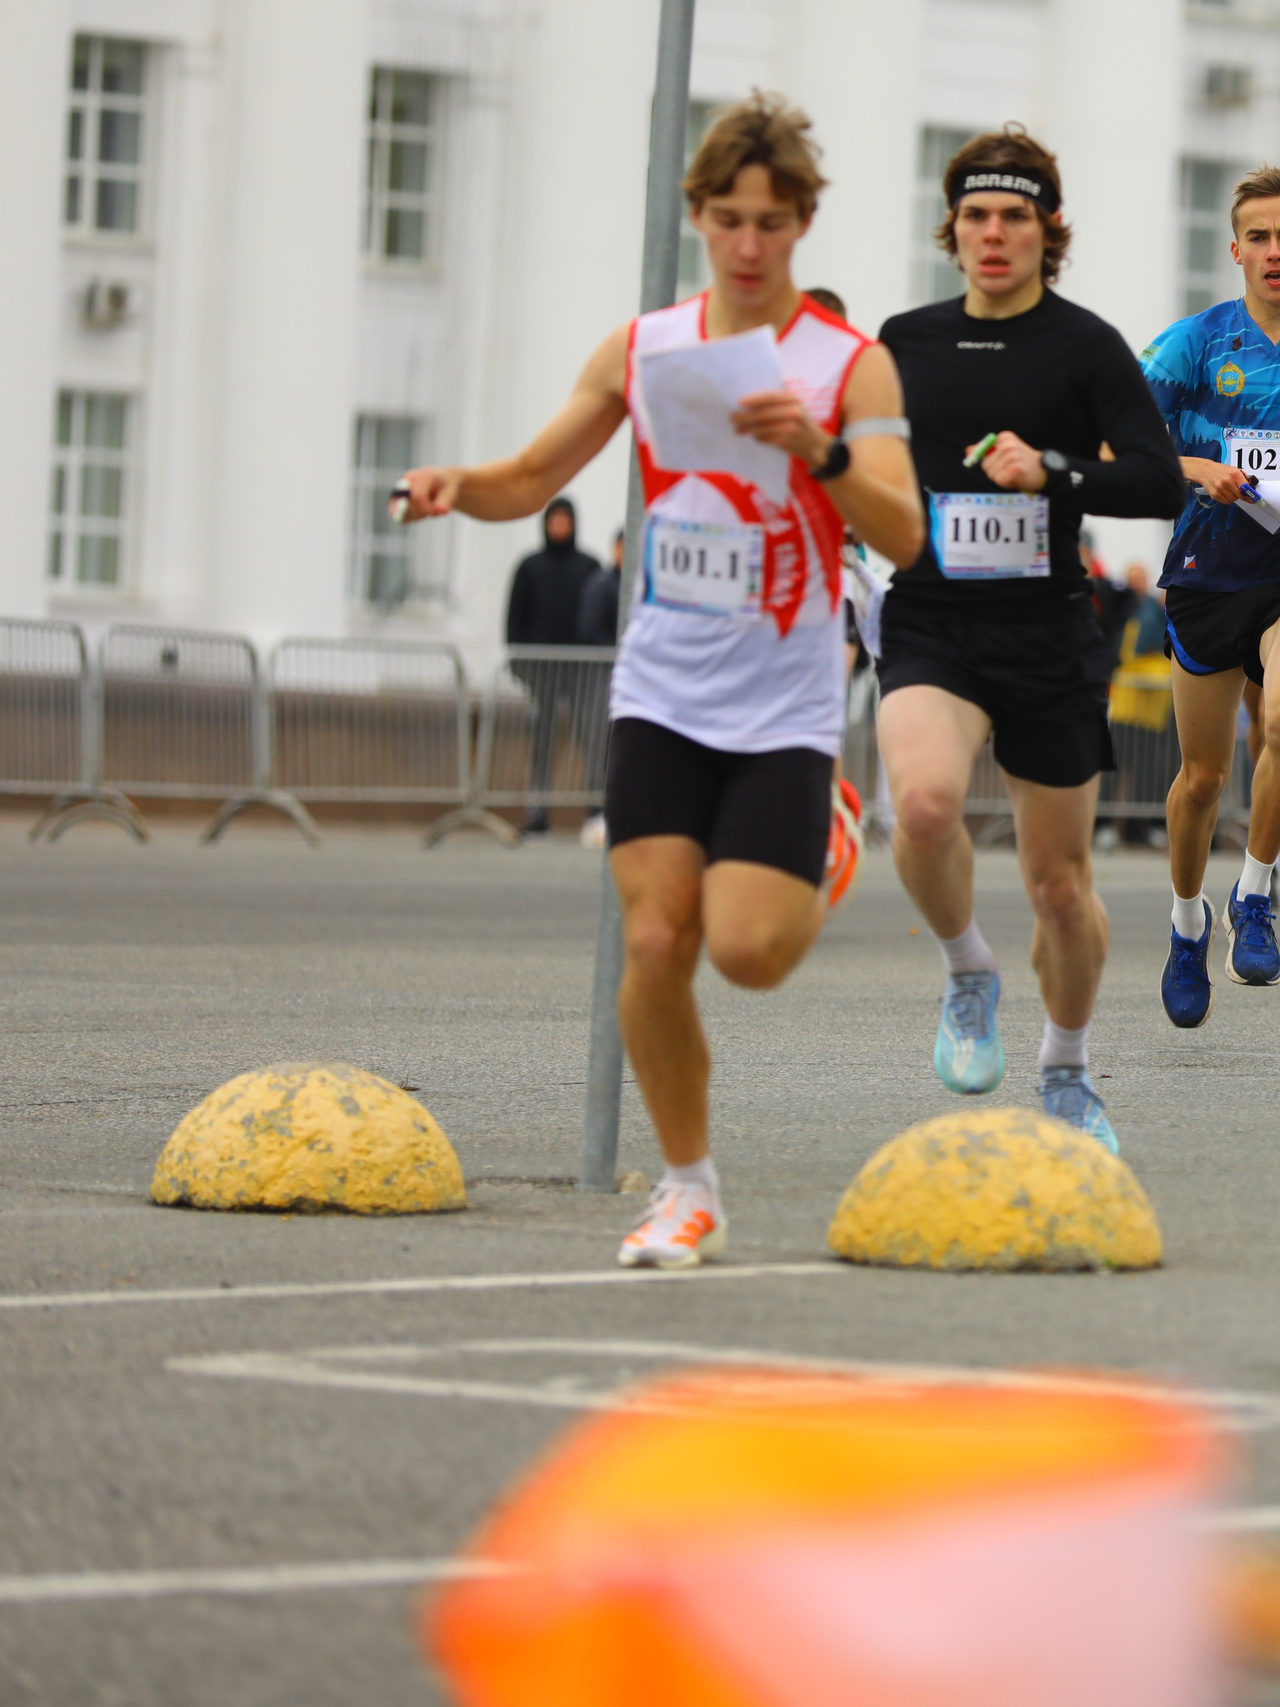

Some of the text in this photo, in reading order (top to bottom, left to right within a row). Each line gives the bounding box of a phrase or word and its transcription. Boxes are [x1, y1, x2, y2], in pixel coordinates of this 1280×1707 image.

[964, 173, 1041, 196] noname
[951, 516, 1027, 544] 110.1
[658, 541, 740, 580] 101.1
